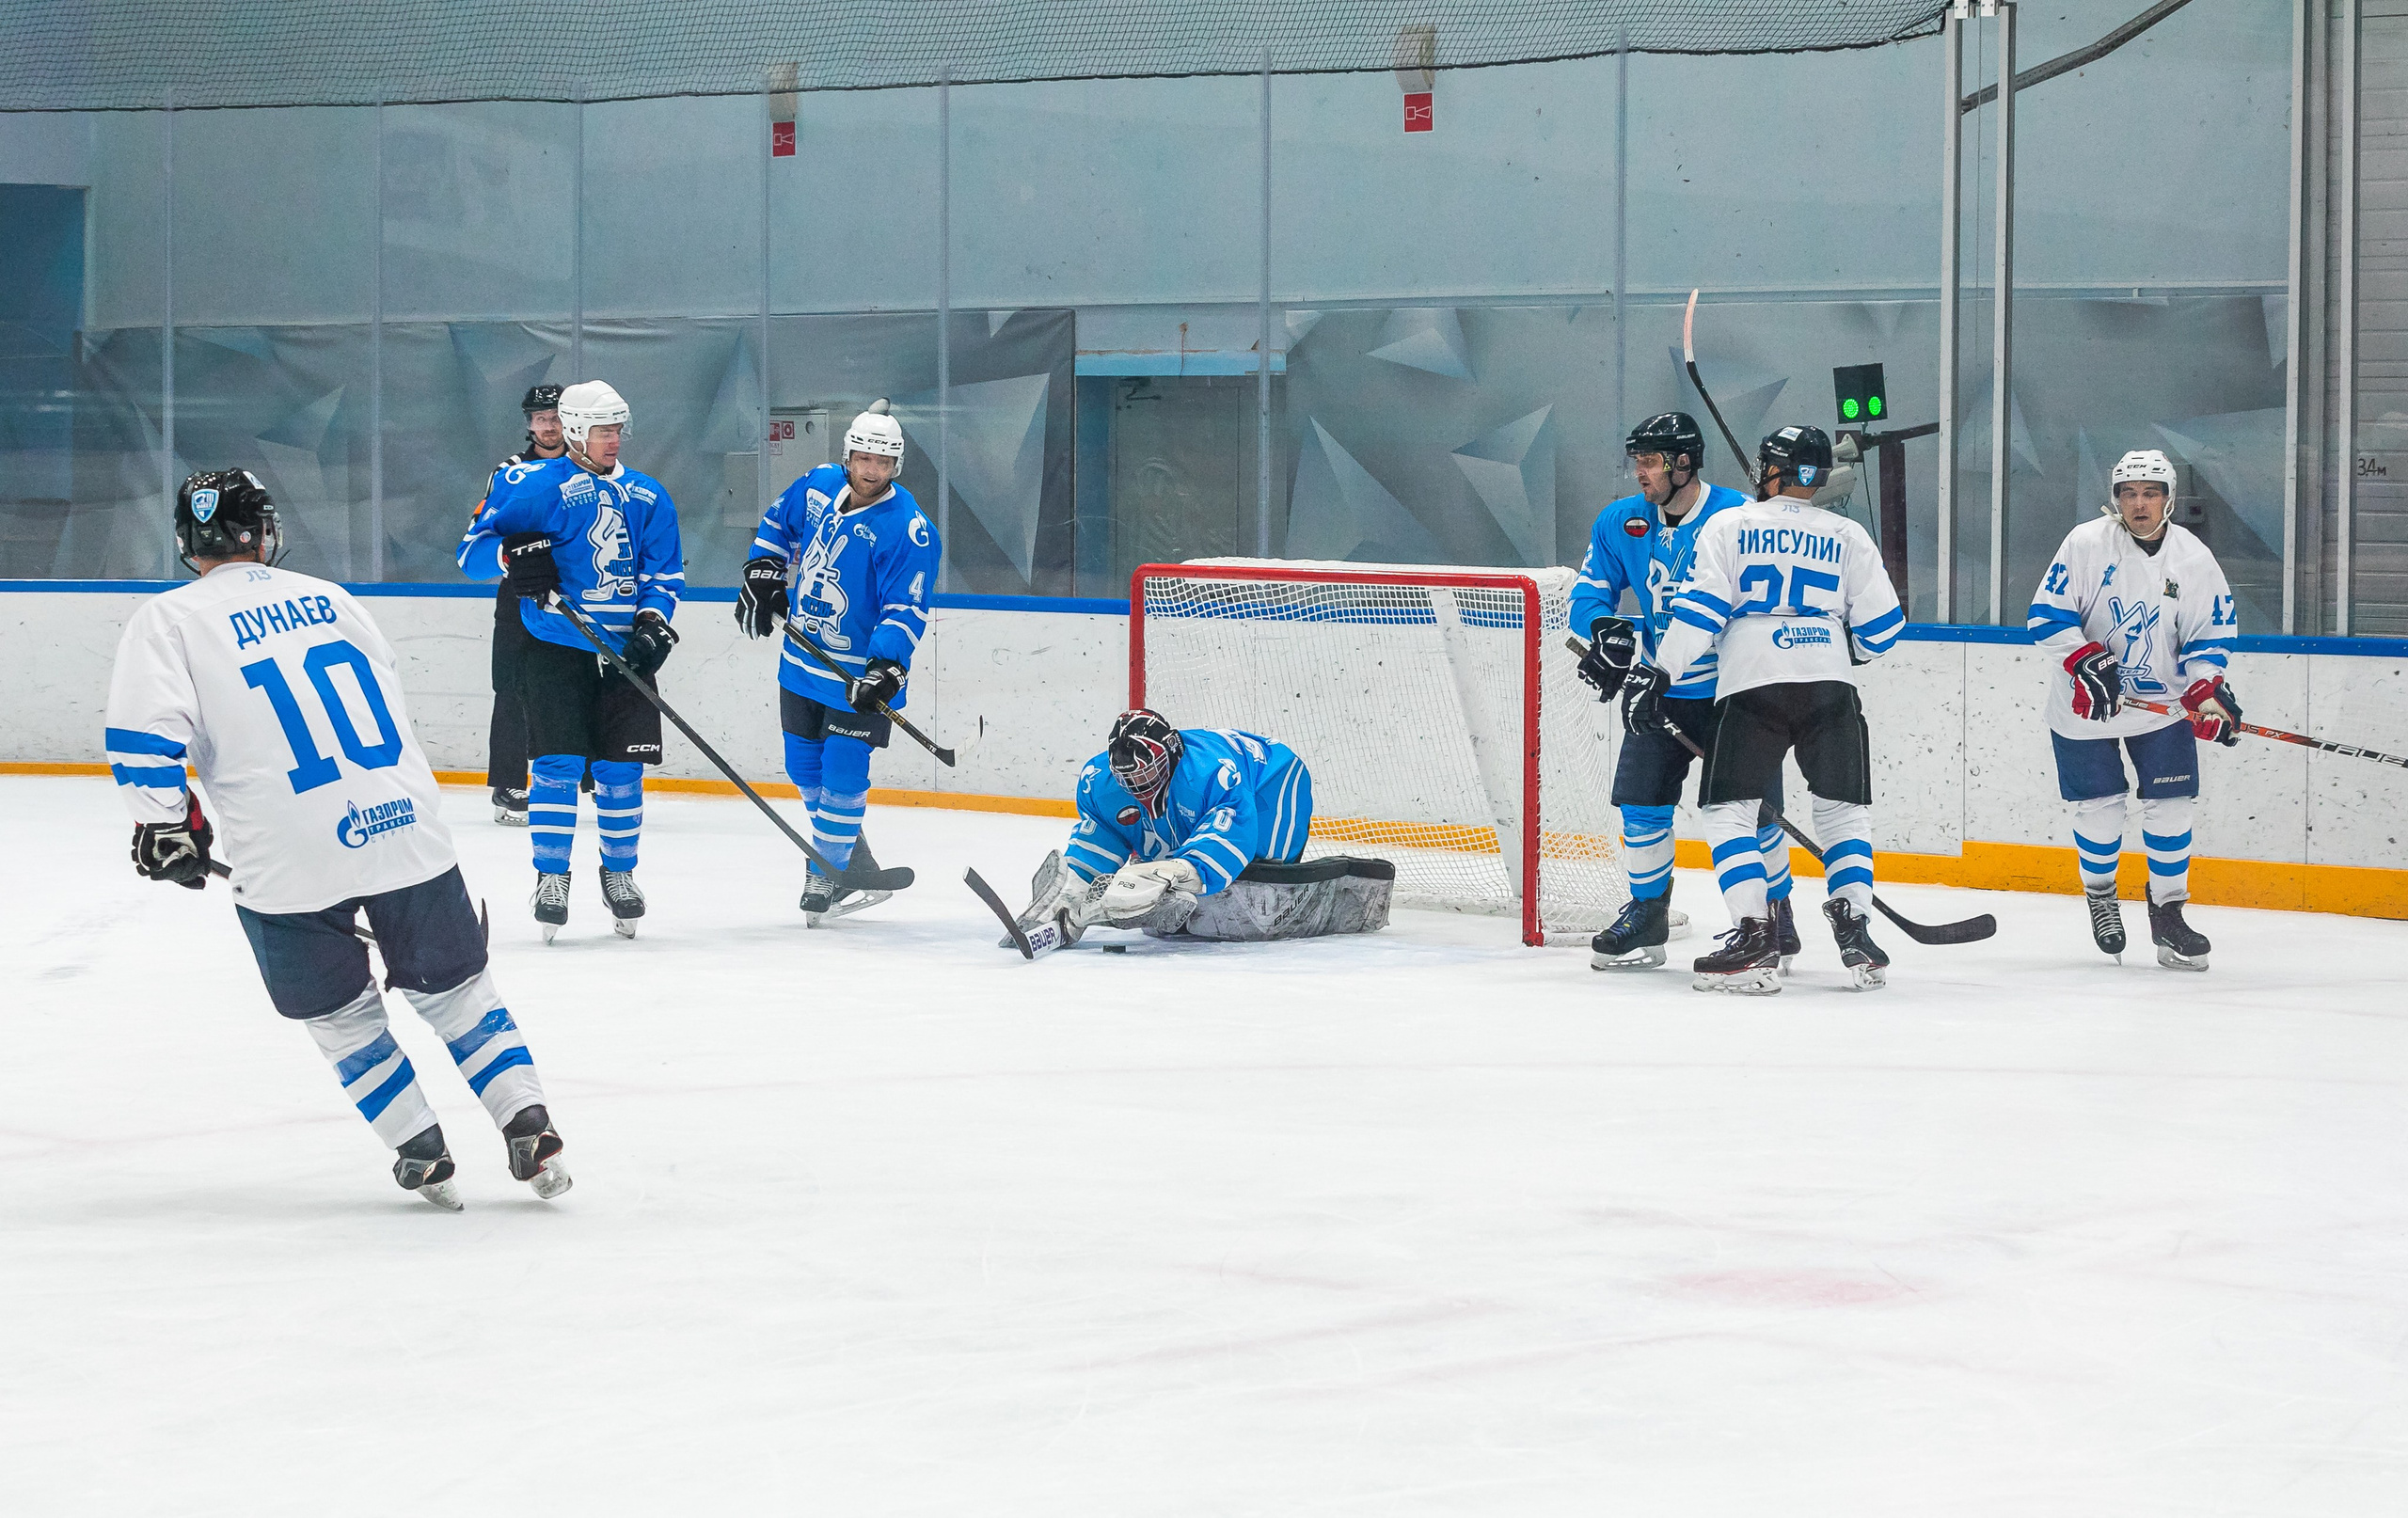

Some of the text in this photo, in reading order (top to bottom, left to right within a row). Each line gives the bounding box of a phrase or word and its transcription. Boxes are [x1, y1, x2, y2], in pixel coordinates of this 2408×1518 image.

[511, 539, 551, 556] TRU
[749, 569, 788, 581] BAU
[908, 570, 926, 604] 4
[2045, 562, 2069, 595] 47
[1731, 563, 1840, 618] 25
[229, 595, 338, 650] ДУНАЕВ
[1791, 626, 1831, 638] ГАЗПРОМ
[240, 640, 403, 795] 10
[827, 723, 871, 738] BAUER
[2264, 730, 2284, 739] PX
[626, 744, 660, 753] CCM
[2311, 737, 2407, 767] TRUE
[2152, 774, 2191, 784] BAUER
[361, 798, 414, 826] ГАЗПРОМ
[1274, 884, 1309, 926] BAUER
[1028, 925, 1056, 952] BAUER
